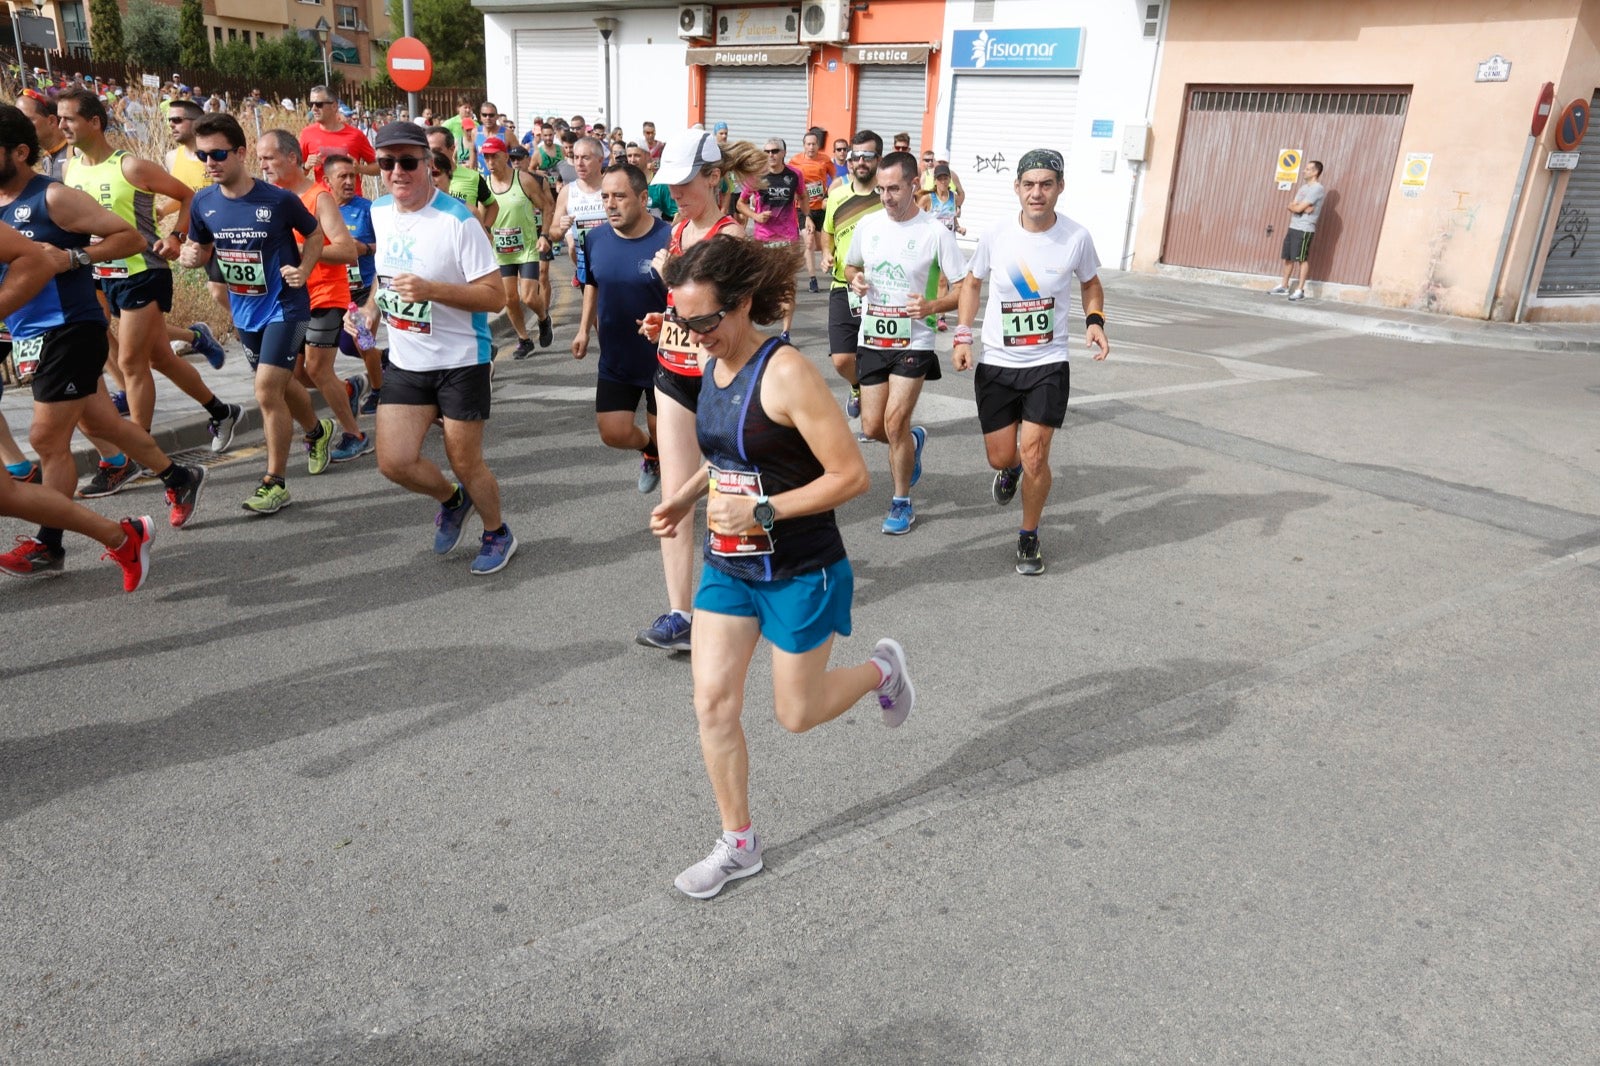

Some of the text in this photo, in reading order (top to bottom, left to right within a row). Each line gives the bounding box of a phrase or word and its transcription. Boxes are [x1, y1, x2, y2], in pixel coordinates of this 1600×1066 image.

[986, 38, 1058, 59] fisiomar
[241, 231, 268, 239] PAZITO
[499, 235, 519, 246] 353
[223, 263, 256, 282] 738
[875, 319, 898, 335] 60
[1011, 313, 1049, 333] 119
[665, 325, 700, 348] 212
